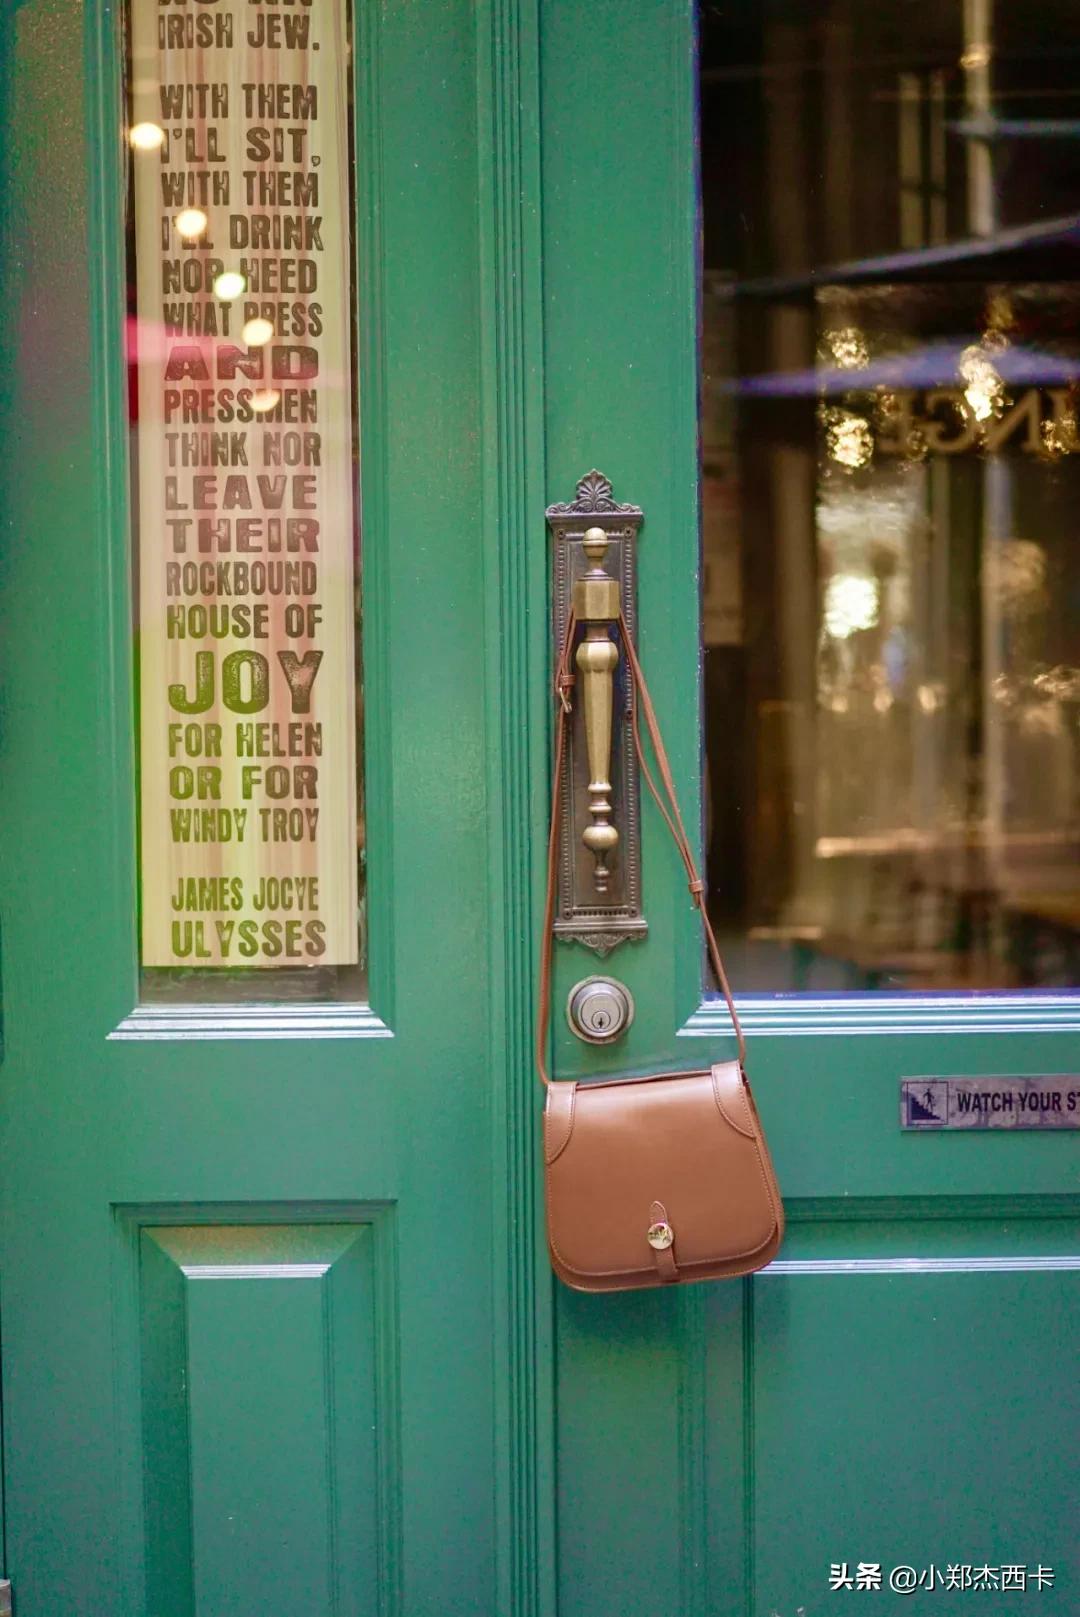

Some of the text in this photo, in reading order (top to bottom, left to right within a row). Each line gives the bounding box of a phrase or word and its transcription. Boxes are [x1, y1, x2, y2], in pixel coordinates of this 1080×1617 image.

[158, 13, 320, 50] IRISH JEW.
[160, 83, 318, 120] WITH THEM
[160, 127, 321, 167] I'LL SIT,
[161, 170, 319, 207] WITH THEM
[229, 214, 324, 251] DRINK
[162, 257, 318, 294] NOR HEED
[163, 301, 323, 337] WHAT PRESS
[164, 345, 319, 381] AND
[164, 388, 318, 425] PRESSMEN
[165, 431, 322, 467] THINK NOR
[165, 475, 317, 510] LEAVE
[166, 518, 320, 553] THEIR
[166, 561, 317, 597] ROCKBOUND
[167, 604, 323, 639] HOUSE OF
[168, 650, 324, 715] JOY
[168, 722, 323, 758] FOR HELEN
[169, 765, 318, 800] OR FOR
[170, 807, 320, 843] WINDY TROY
[171, 876, 319, 912] JAMES JOCYE
[171, 919, 326, 958] ULYSSES
[957, 1091, 1080, 1113] WATCH YOUR S
